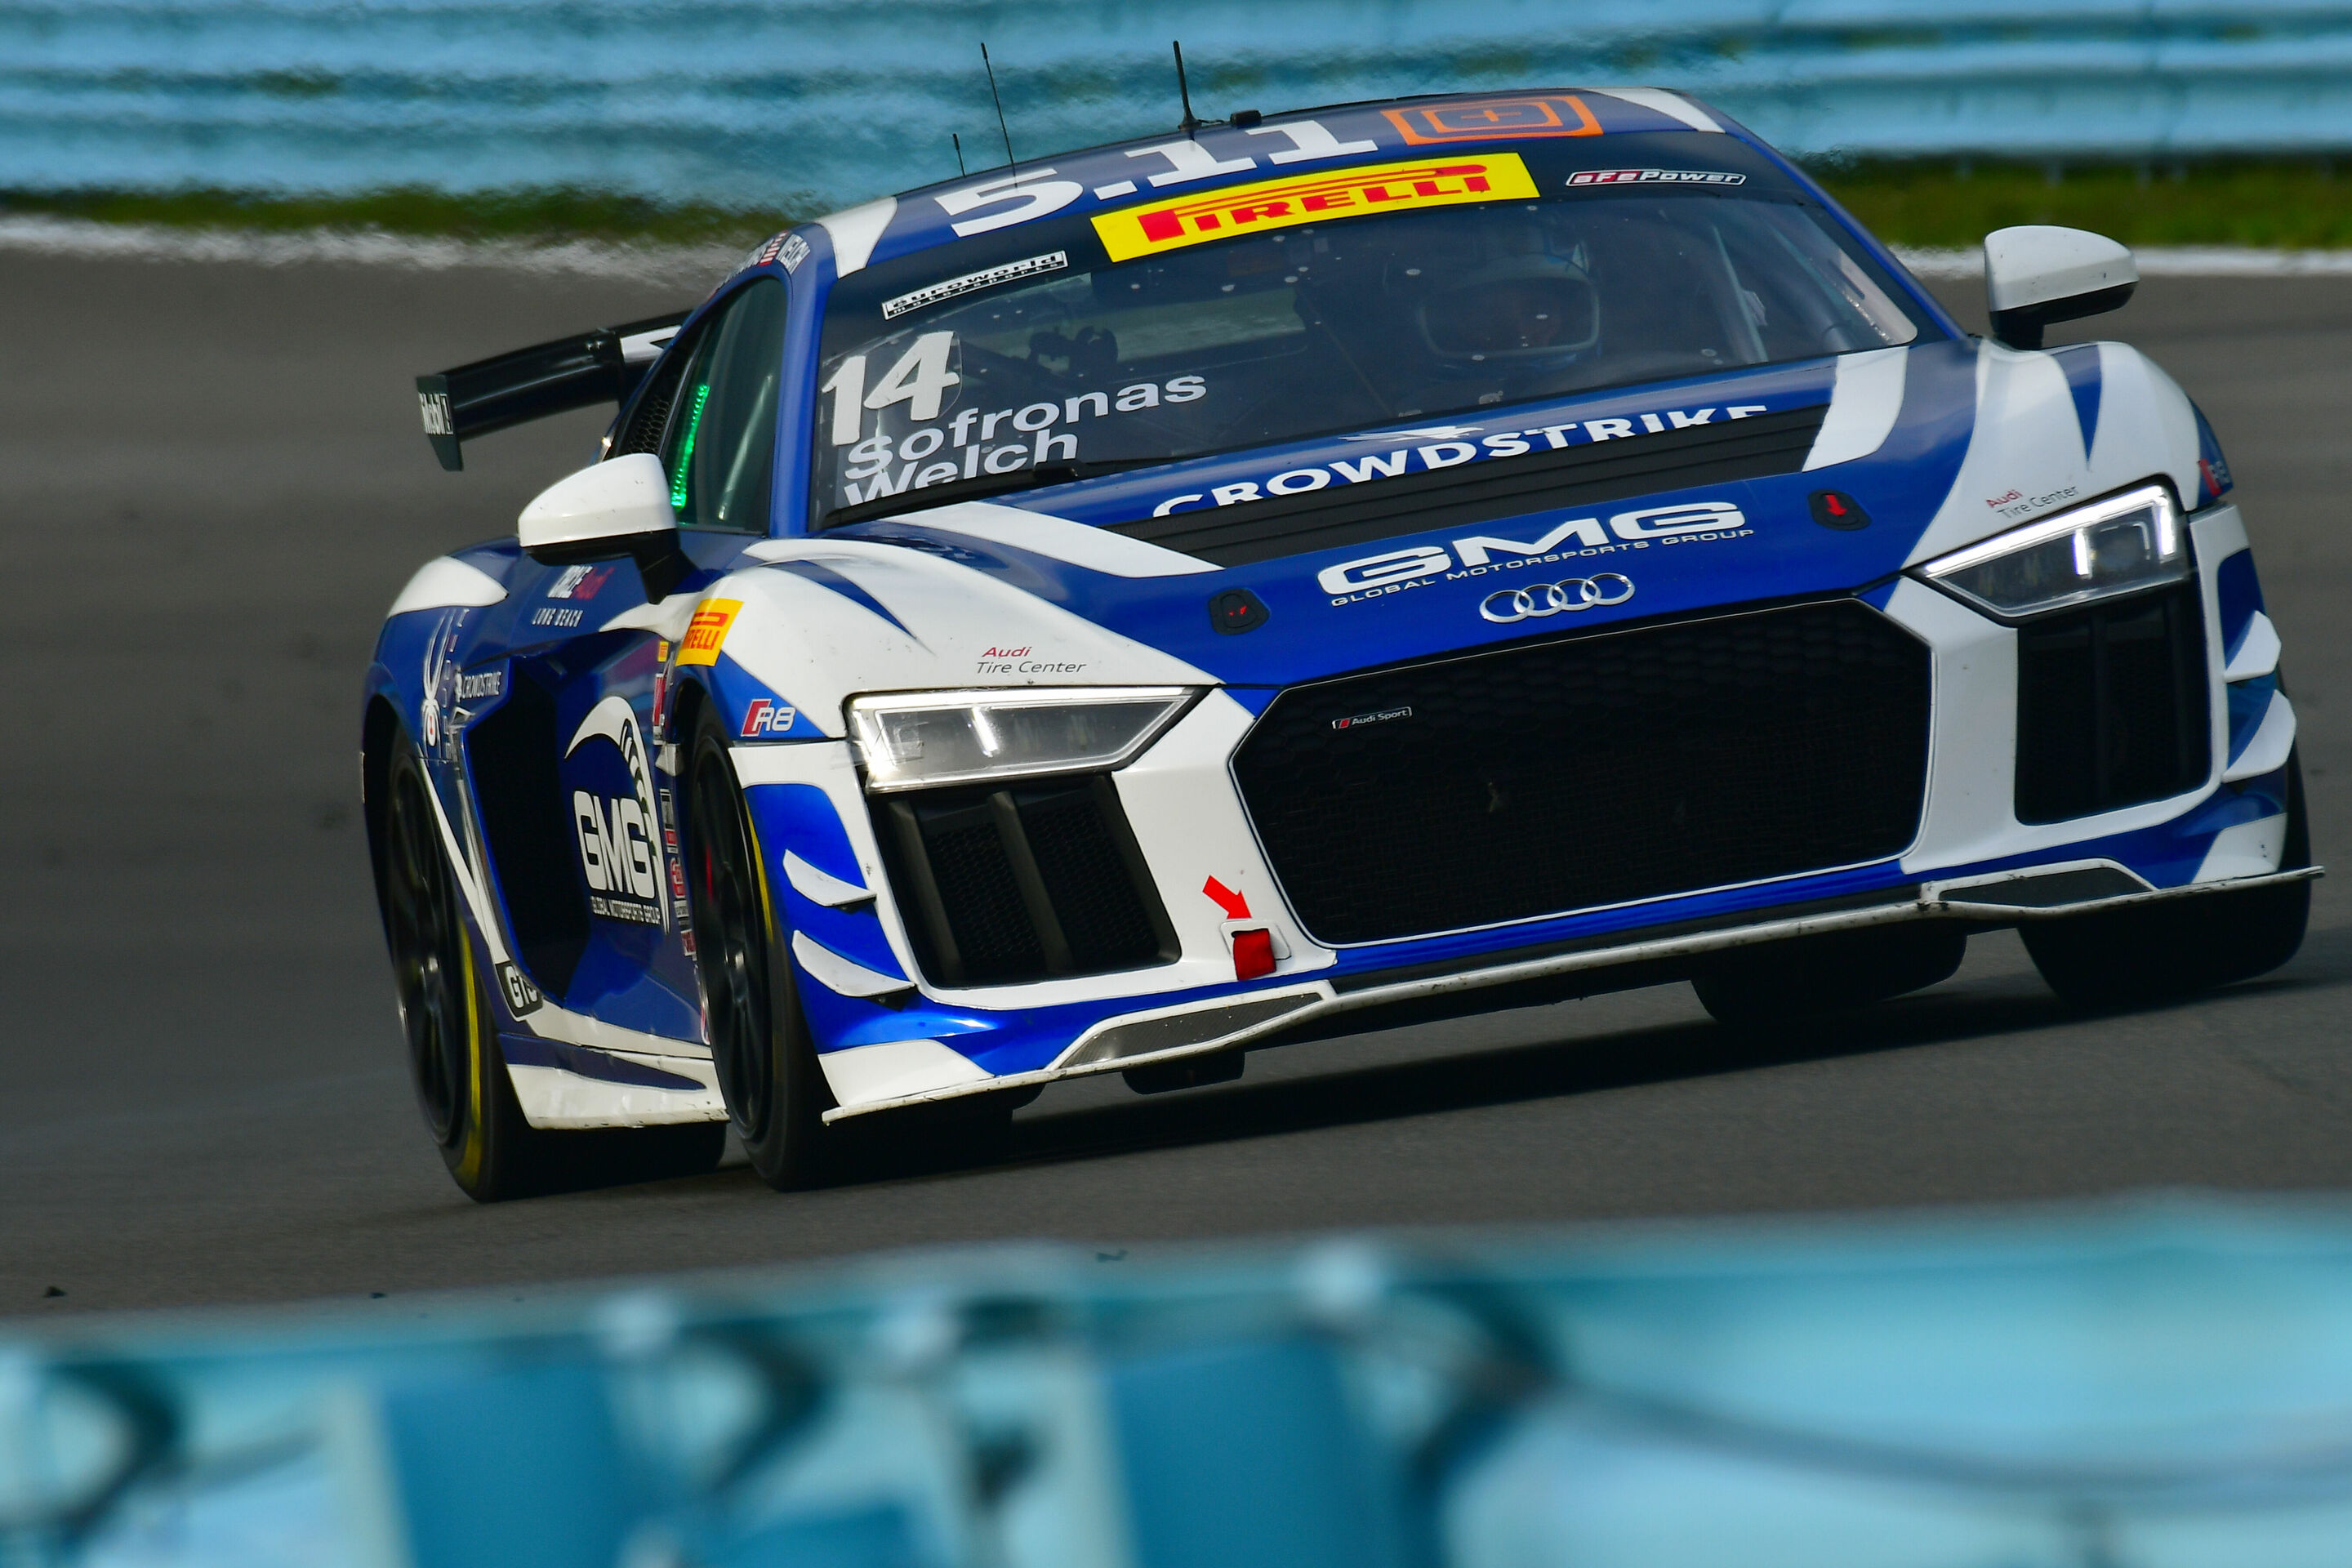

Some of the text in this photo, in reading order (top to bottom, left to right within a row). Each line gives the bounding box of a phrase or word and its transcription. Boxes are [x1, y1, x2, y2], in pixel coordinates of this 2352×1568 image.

[934, 119, 1379, 238] 5.11
[1138, 164, 1491, 243] PIRELLI
[822, 331, 960, 446] 14
[844, 375, 1208, 480] Sofronas
[844, 429, 1079, 507] Welch
[1986, 489, 2023, 508] Audi
[1997, 487, 2078, 519] Tire Center
[1317, 501, 1746, 596] GMG
[1331, 528, 1755, 607] GLOBAL MOTORSPORTS GROUP
[681, 612, 729, 651] PRELLI
[977, 661, 1088, 674] Tire Center
[982, 646, 1032, 657] Audi
[746, 704, 796, 733] R8
[1352, 710, 1408, 726] Audi Sport
[573, 791, 654, 898] GMG
